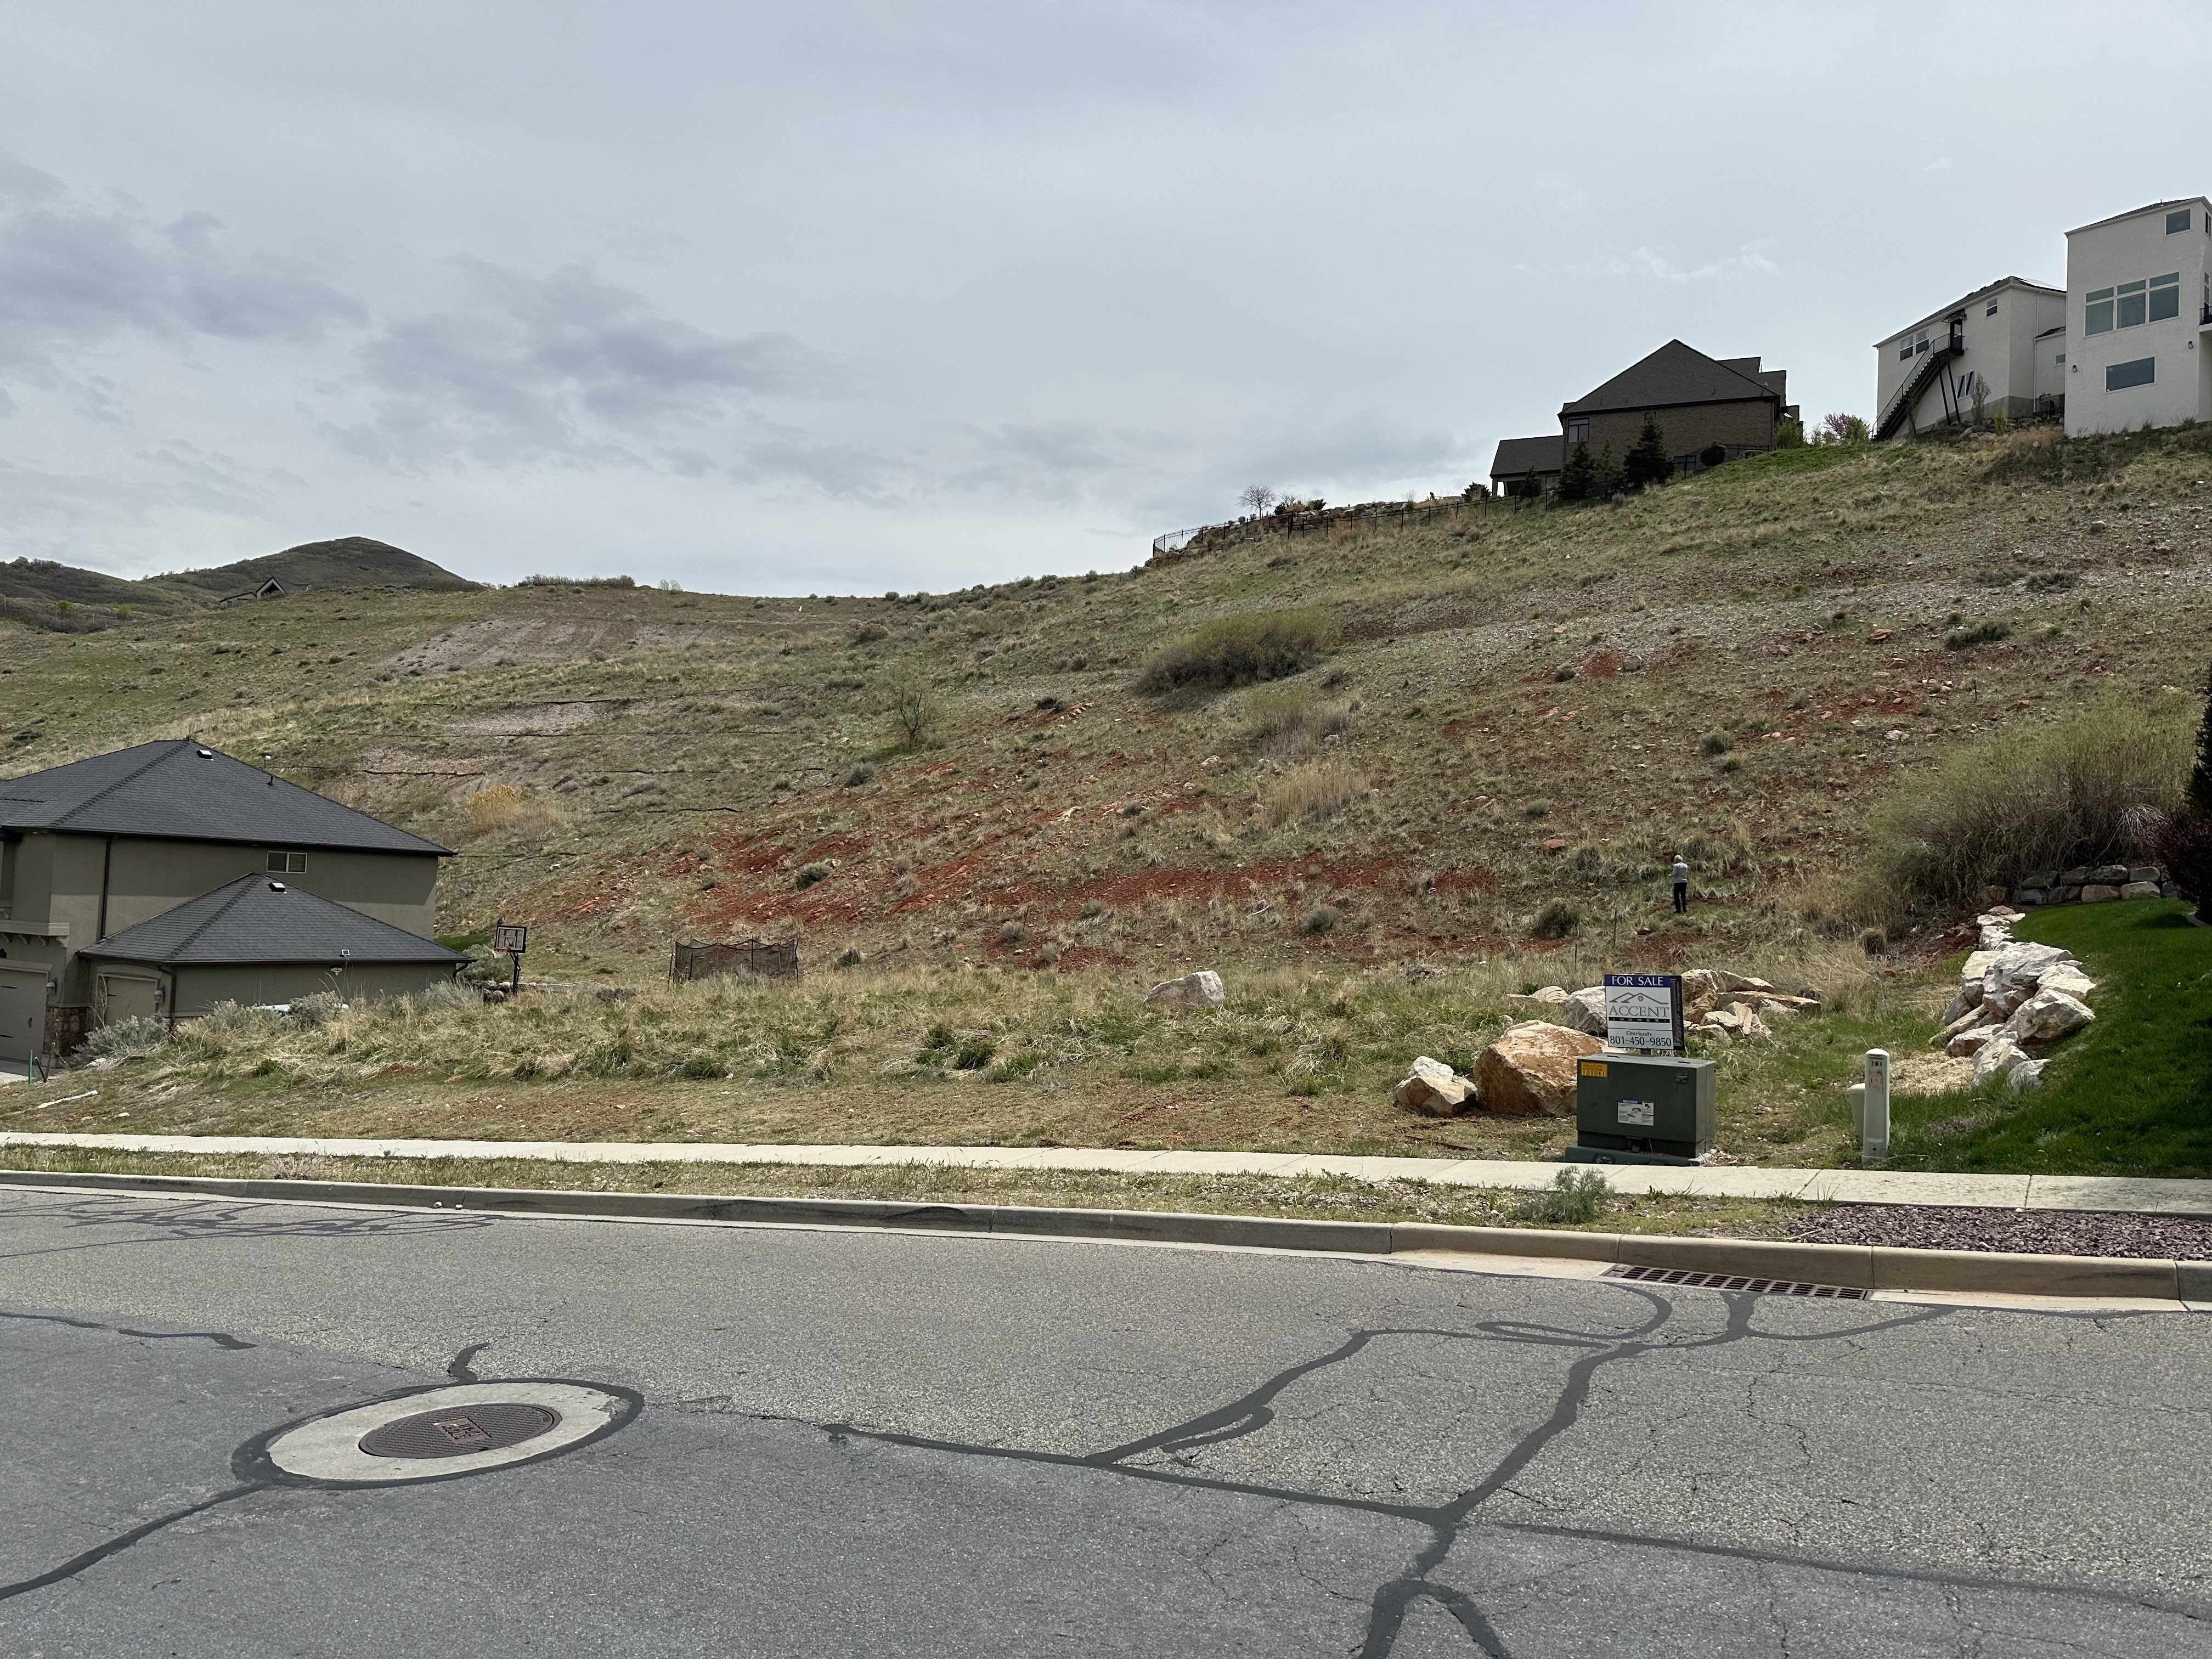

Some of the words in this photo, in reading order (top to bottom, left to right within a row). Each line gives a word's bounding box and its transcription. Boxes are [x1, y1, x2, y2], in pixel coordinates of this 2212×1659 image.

[1612, 976, 1633, 985] FOR
[1638, 977, 1663, 986] SALE
[1609, 1006, 1669, 1017] ACCENT
[1610, 1035, 1672, 1047] 801-450-9850
